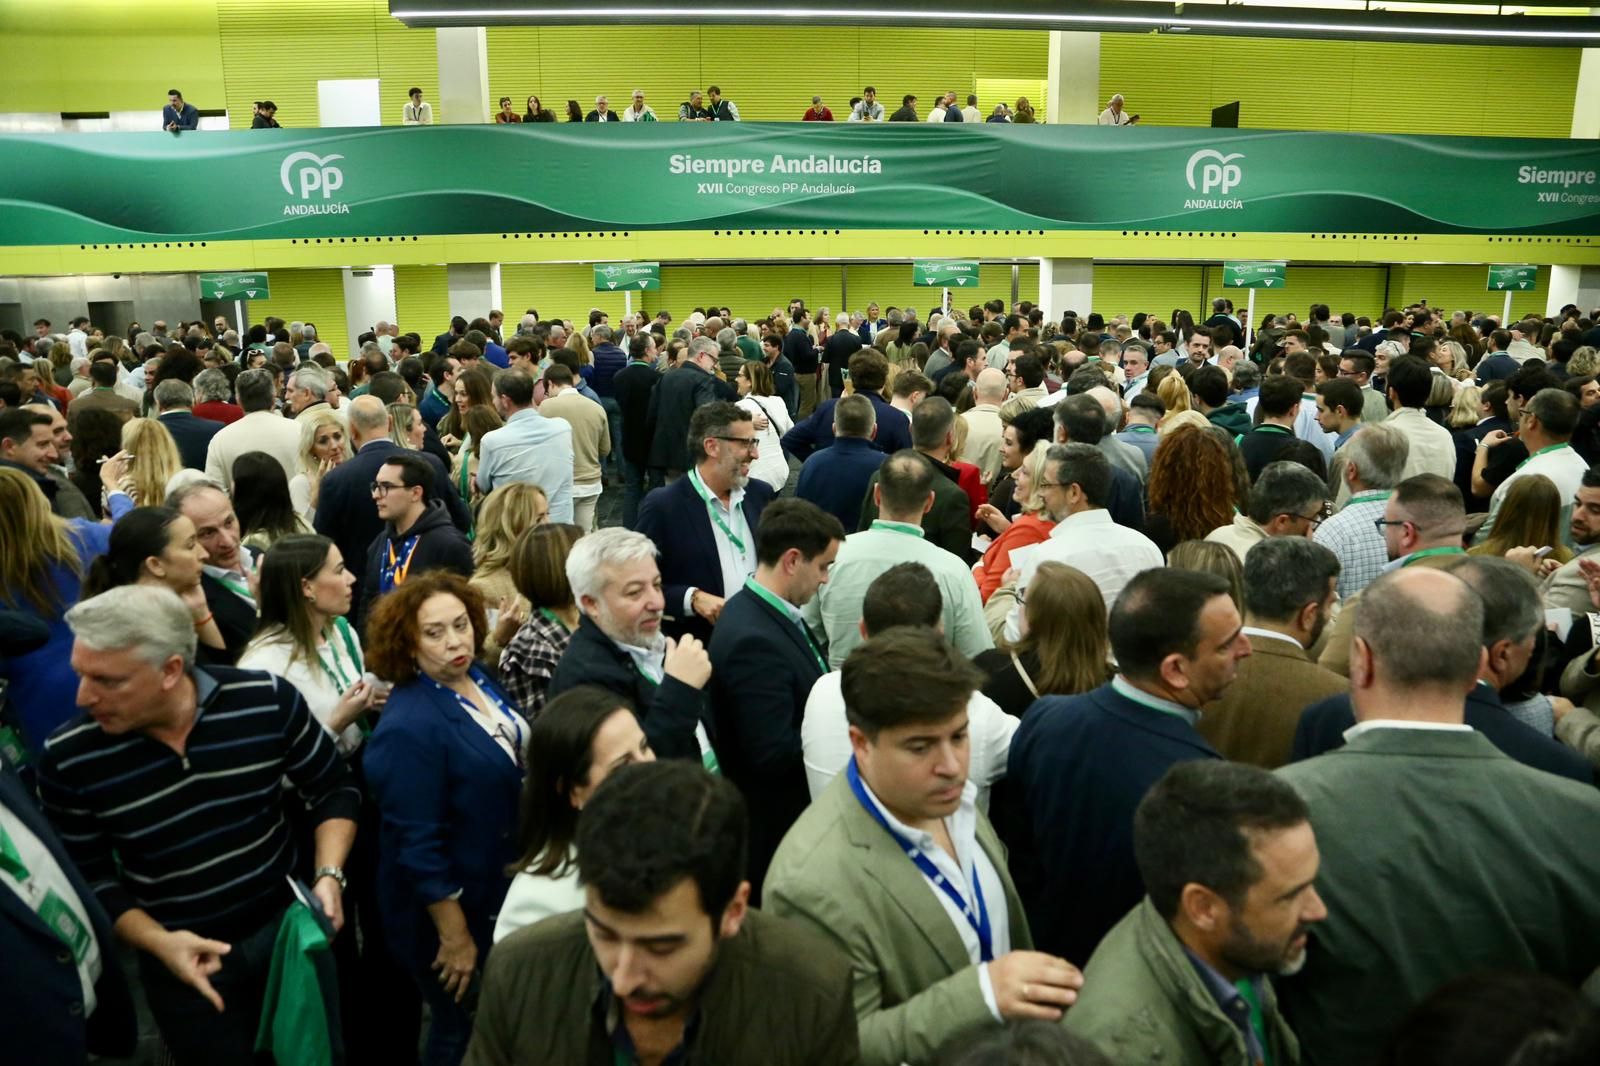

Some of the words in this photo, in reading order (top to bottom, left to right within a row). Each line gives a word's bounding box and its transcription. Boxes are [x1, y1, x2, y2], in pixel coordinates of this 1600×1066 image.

[669, 154, 765, 177] Siempre
[770, 154, 882, 174] Andalucía
[1518, 165, 1596, 188] Siempre
[697, 183, 723, 194] XVII
[725, 183, 780, 196] Congreso
[782, 183, 799, 193] PP
[801, 183, 855, 194] Andalucía
[1537, 192, 1559, 202] XVII
[283, 202, 350, 216] ANDALUCÍA
[1184, 198, 1244, 210] ANDALUCÍA
